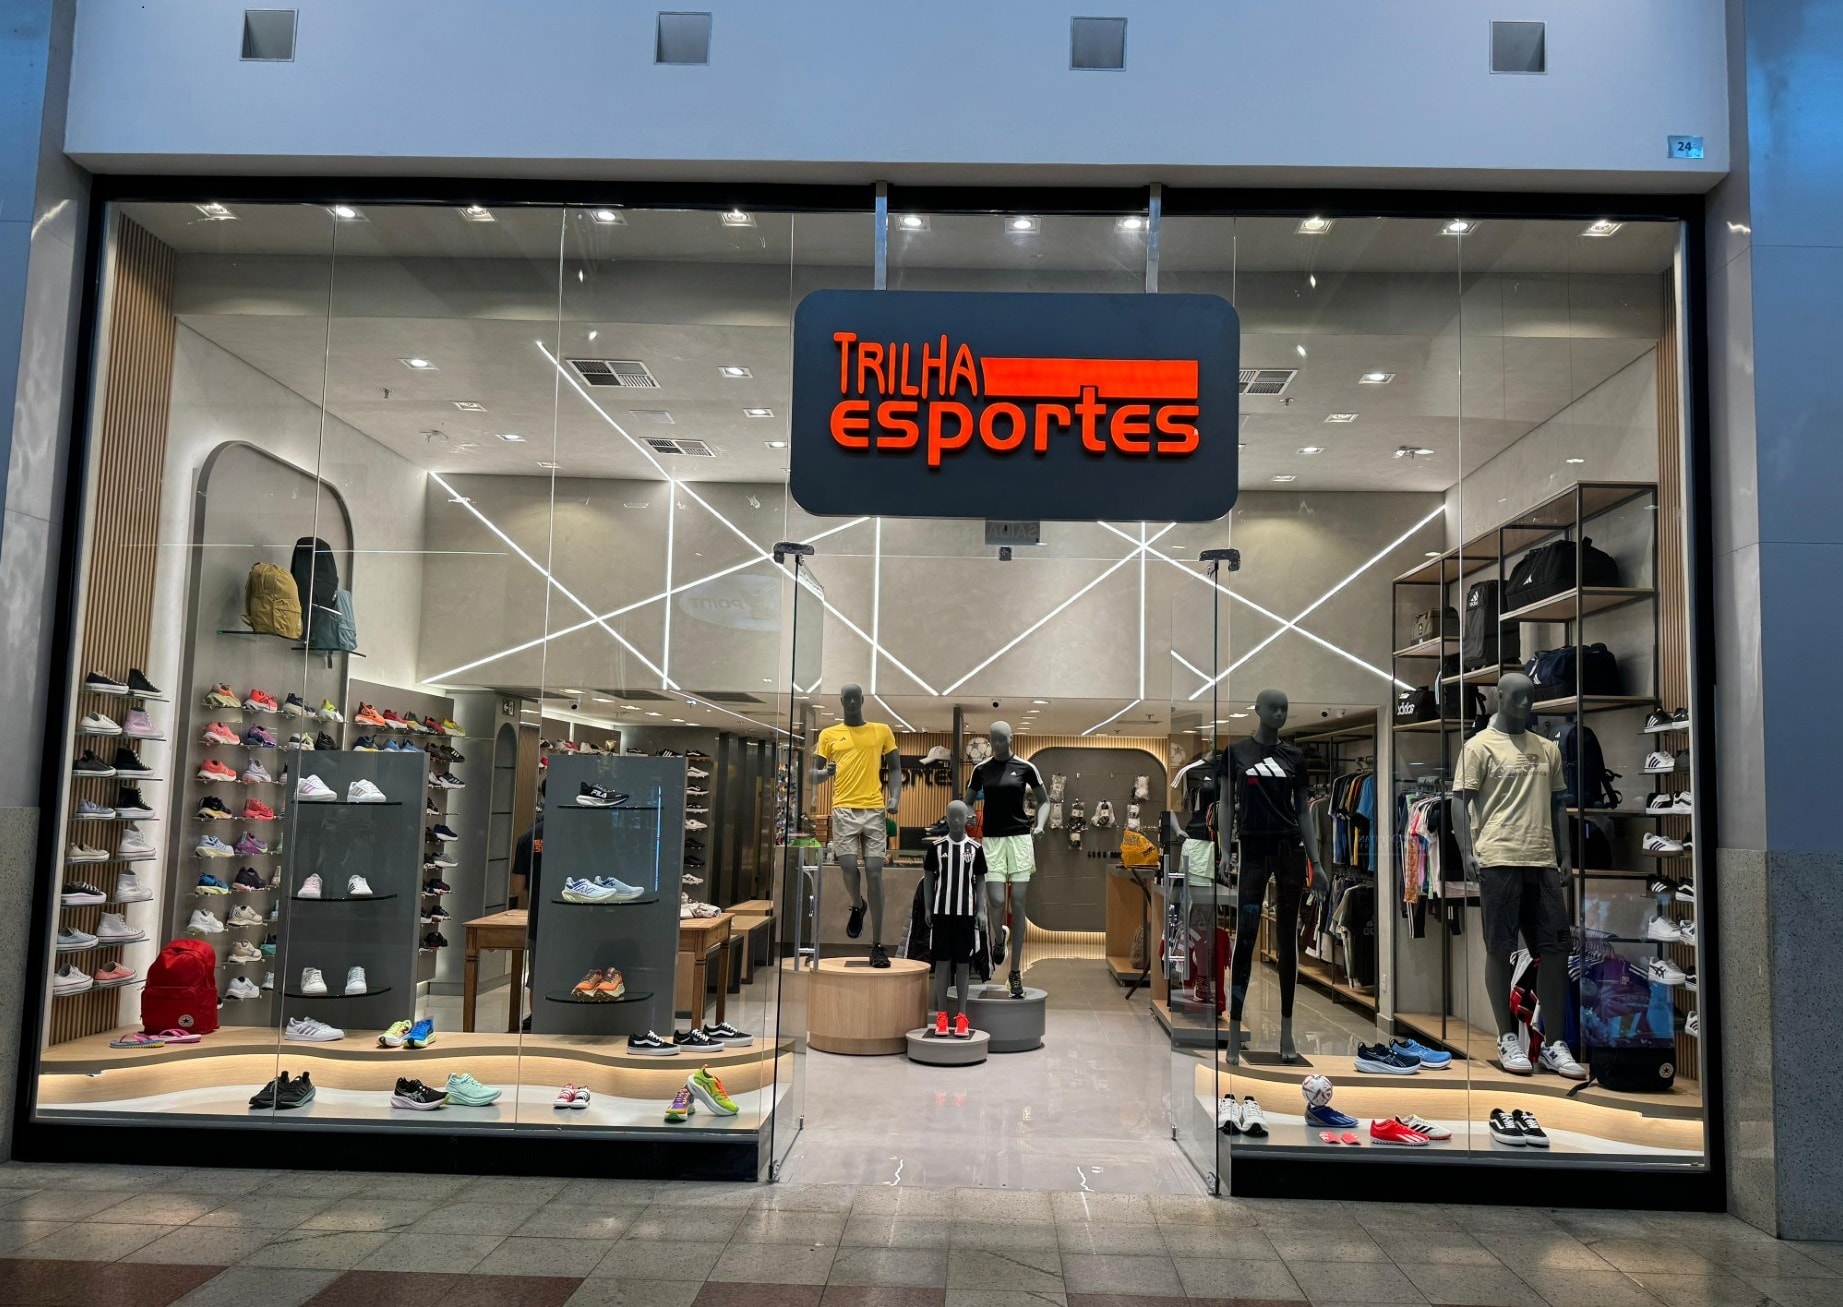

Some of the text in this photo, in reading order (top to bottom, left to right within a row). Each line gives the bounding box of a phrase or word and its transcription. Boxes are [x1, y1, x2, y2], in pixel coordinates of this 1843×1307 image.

[1677, 141, 1692, 152] 24
[833, 331, 979, 400] TRILHA
[590, 789, 608, 799] FILA
